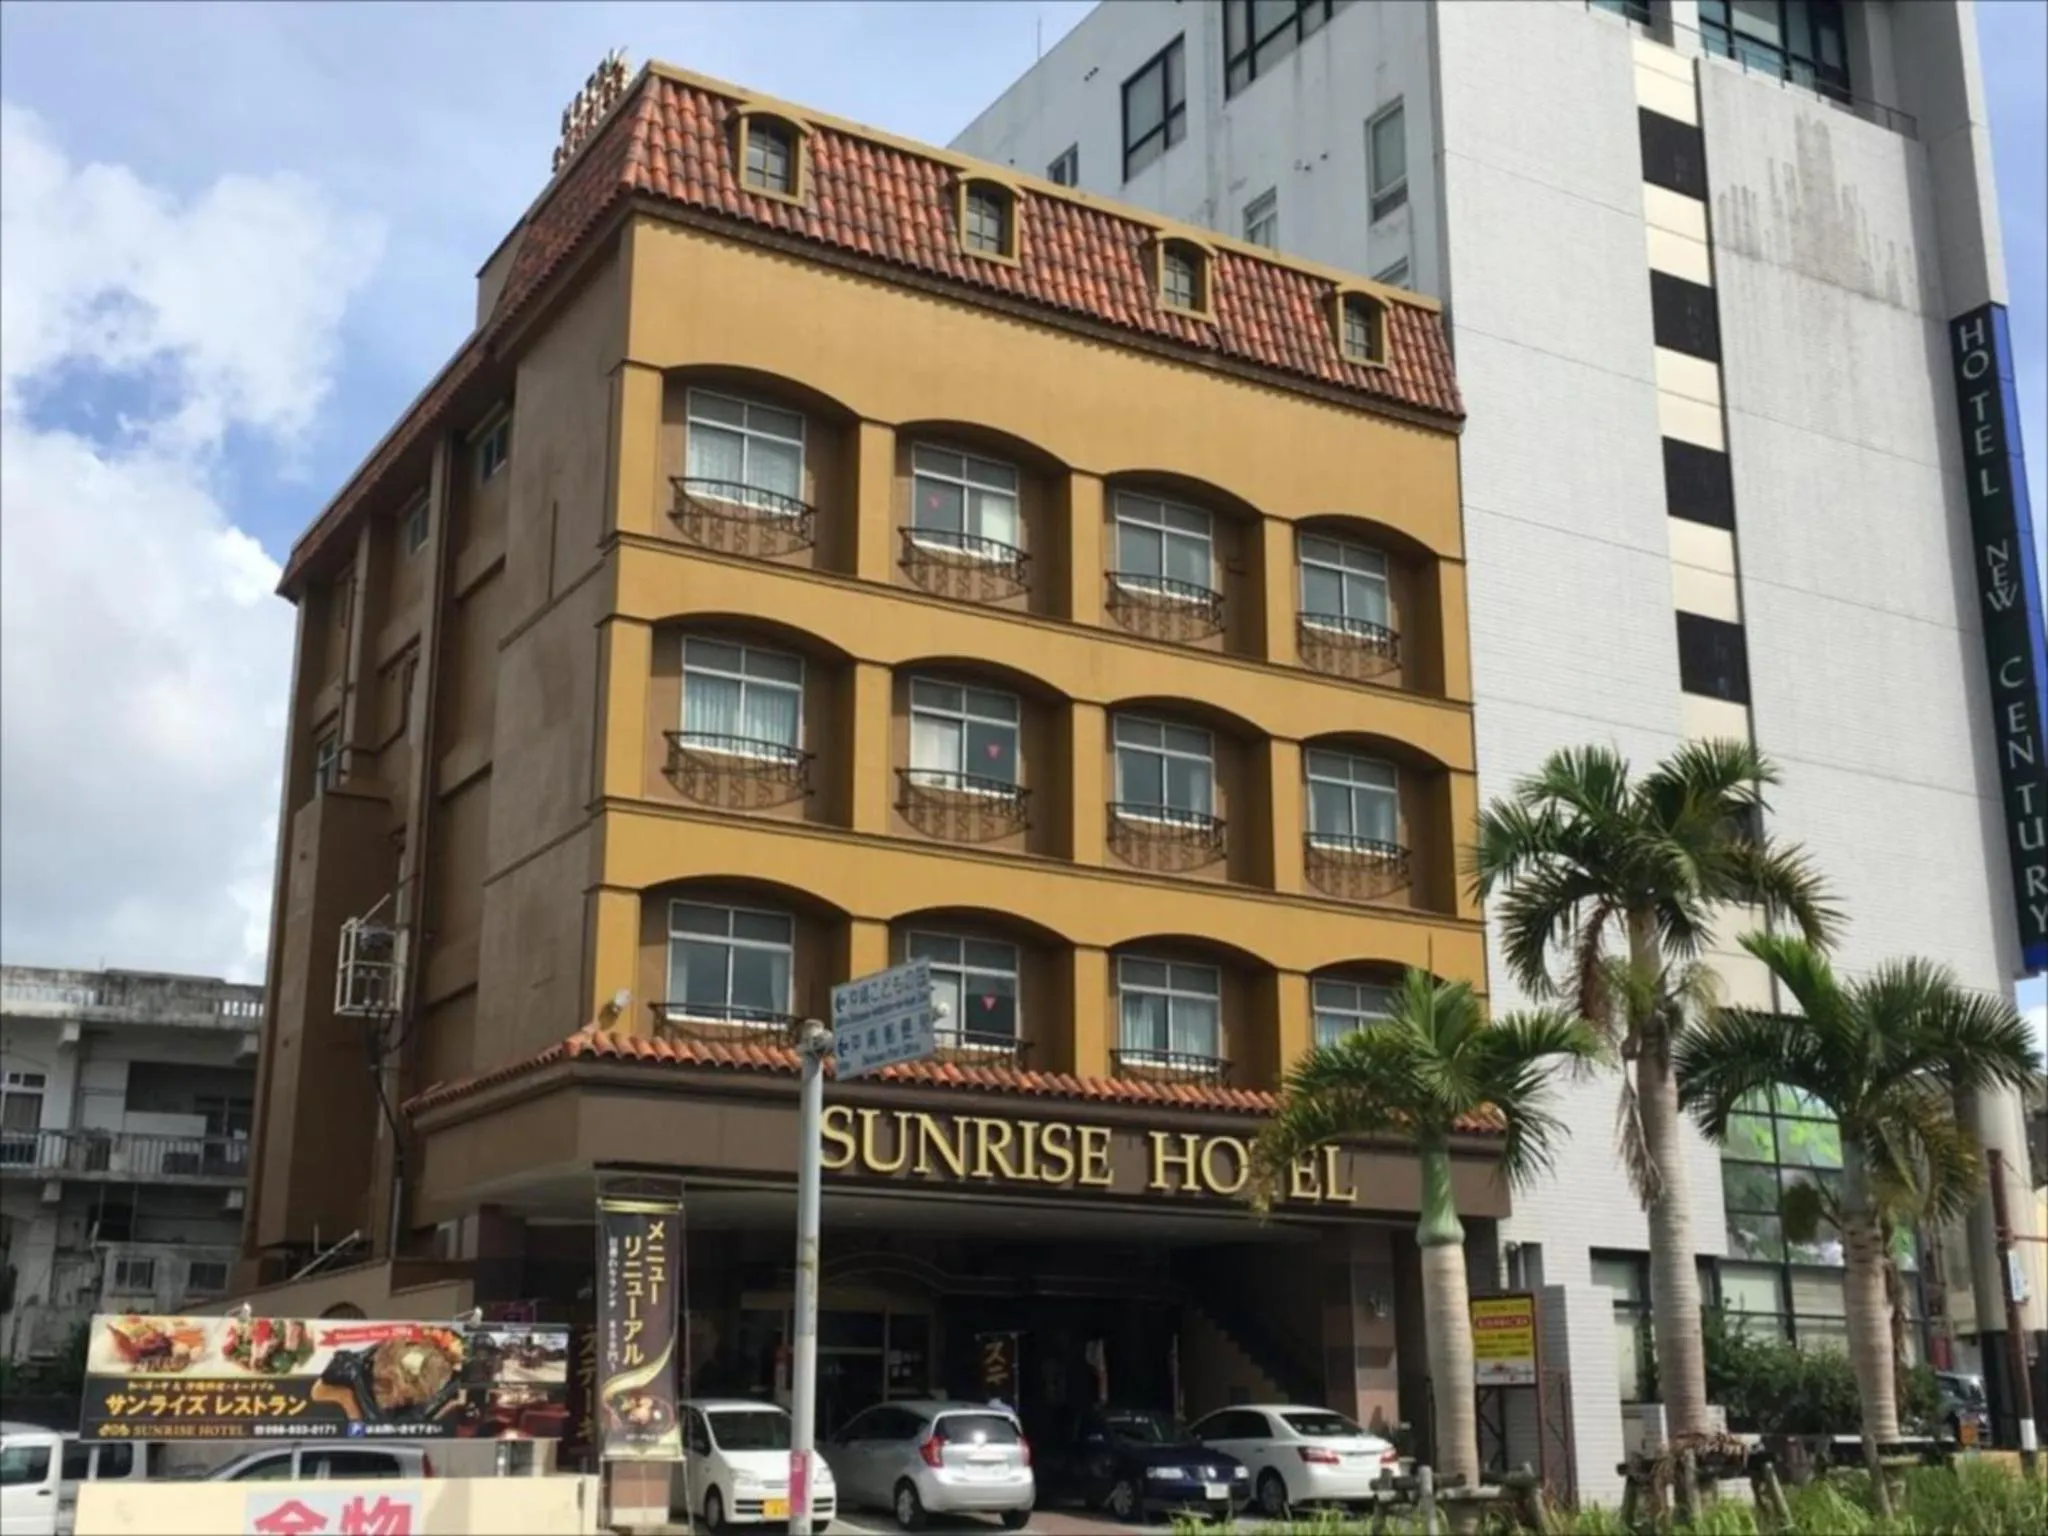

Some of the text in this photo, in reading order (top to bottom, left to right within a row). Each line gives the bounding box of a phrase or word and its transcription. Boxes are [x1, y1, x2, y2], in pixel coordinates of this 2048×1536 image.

[1960, 318, 2048, 932] HOTEL NEW CENTURY
[820, 1104, 1358, 1201] SUNRISE HOEL
[622, 1235, 644, 1365] リニューアル
[645, 1220, 665, 1305] メニュー
[105, 1393, 307, 1416] サンライズ レストラン
[132, 1423, 198, 1437] SUNRISE
[201, 1423, 244, 1437] HOTEL
